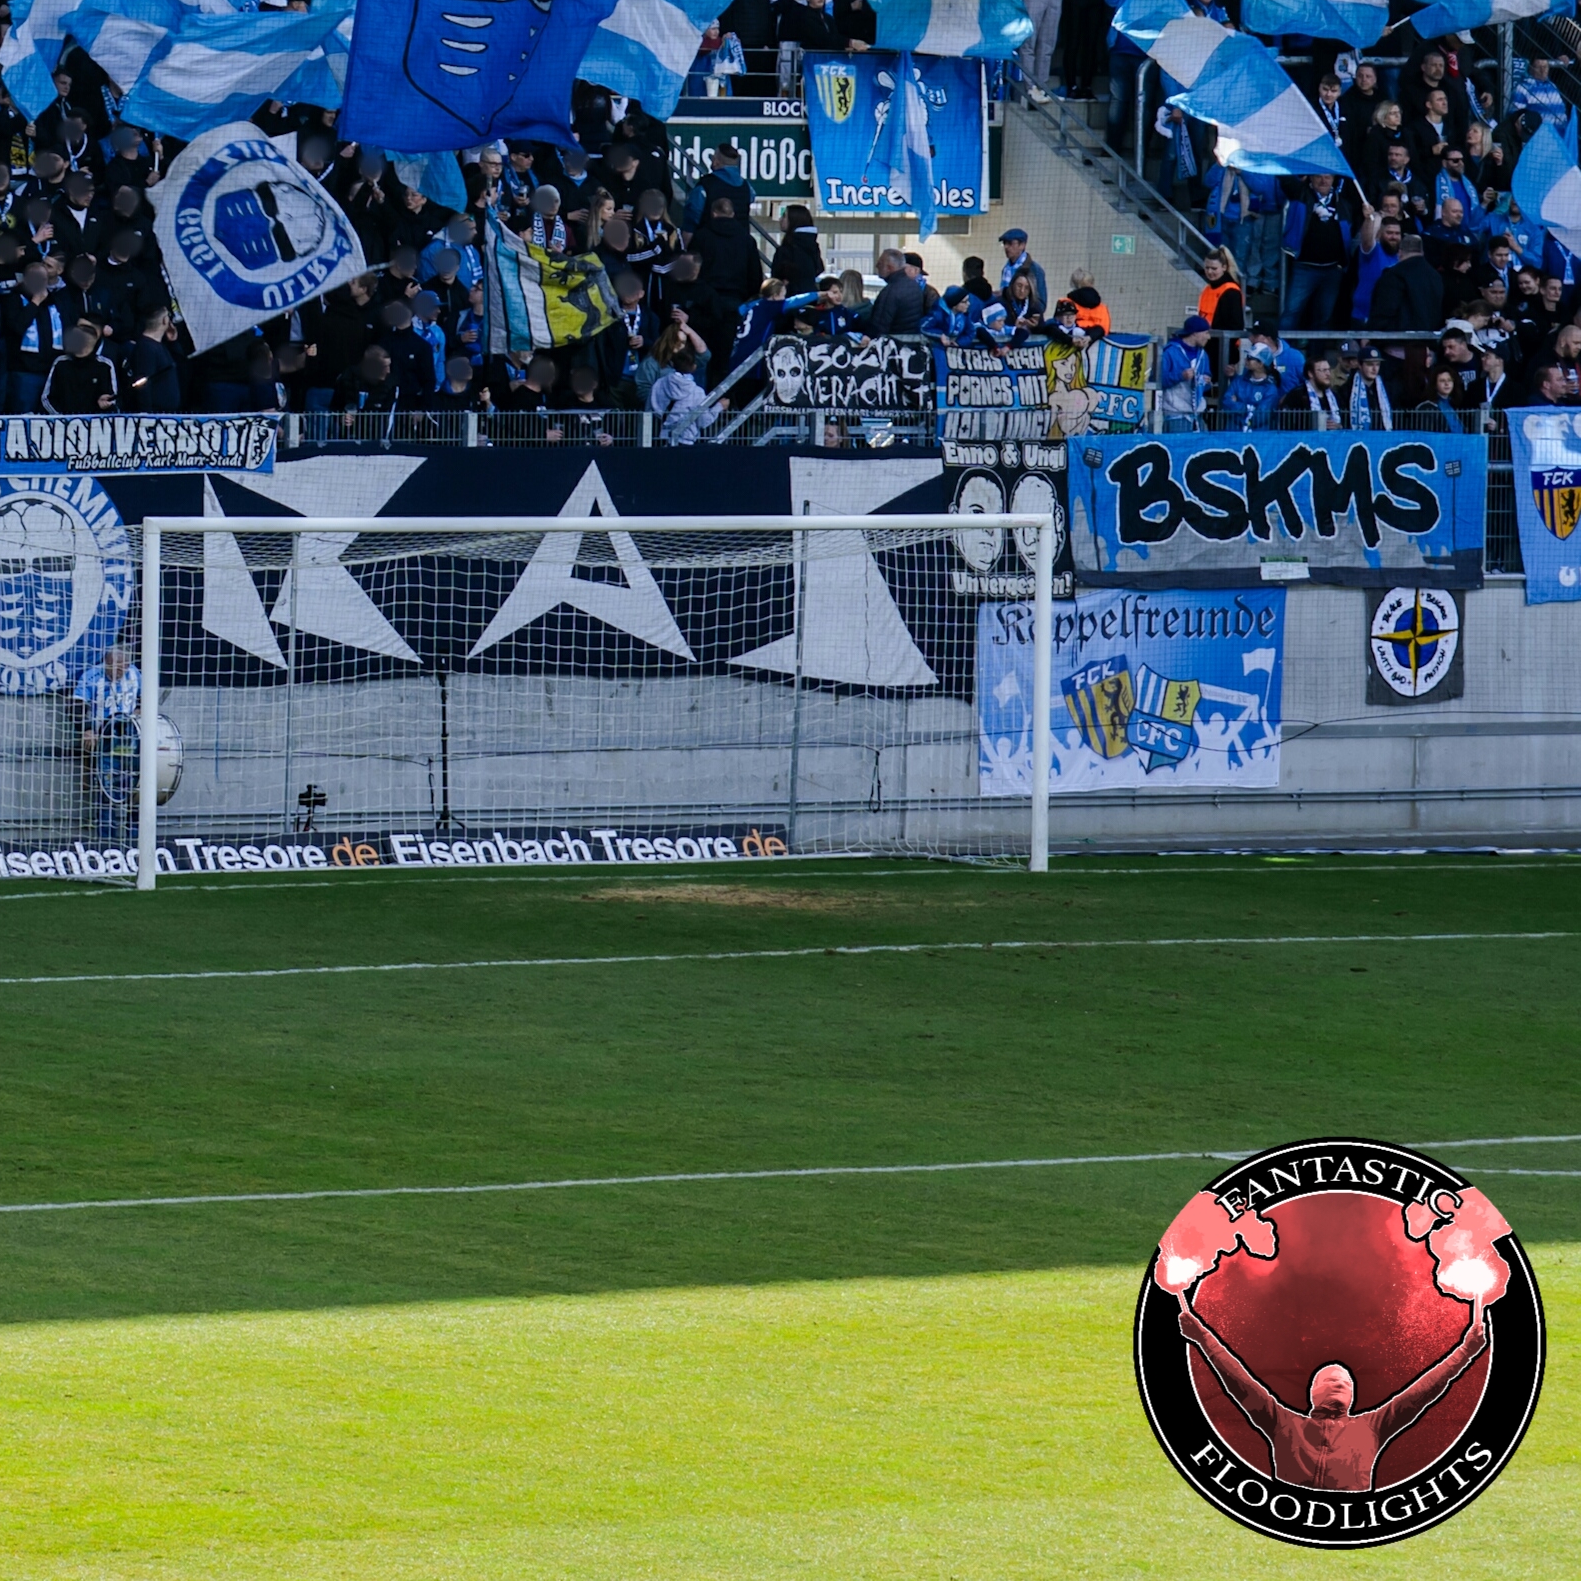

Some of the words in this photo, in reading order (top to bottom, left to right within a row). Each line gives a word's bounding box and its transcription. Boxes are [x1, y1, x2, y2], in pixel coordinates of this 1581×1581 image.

[946, 346, 1004, 372] ULTRAS
[947, 374, 1014, 406] PORNOS
[1017, 374, 1049, 406] MIT
[68, 453, 141, 471] Fußballclub
[145, 451, 243, 469] Karl-Marx-Stadt
[942, 440, 1000, 467] Enno
[1023, 441, 1067, 470] Ungi
[1542, 471, 1574, 486] FCK
[1106, 440, 1442, 549] BSKMS
[1070, 660, 1117, 690] FCK
[1137, 719, 1183, 752] CFC
[389, 829, 594, 866] Eisenbach
